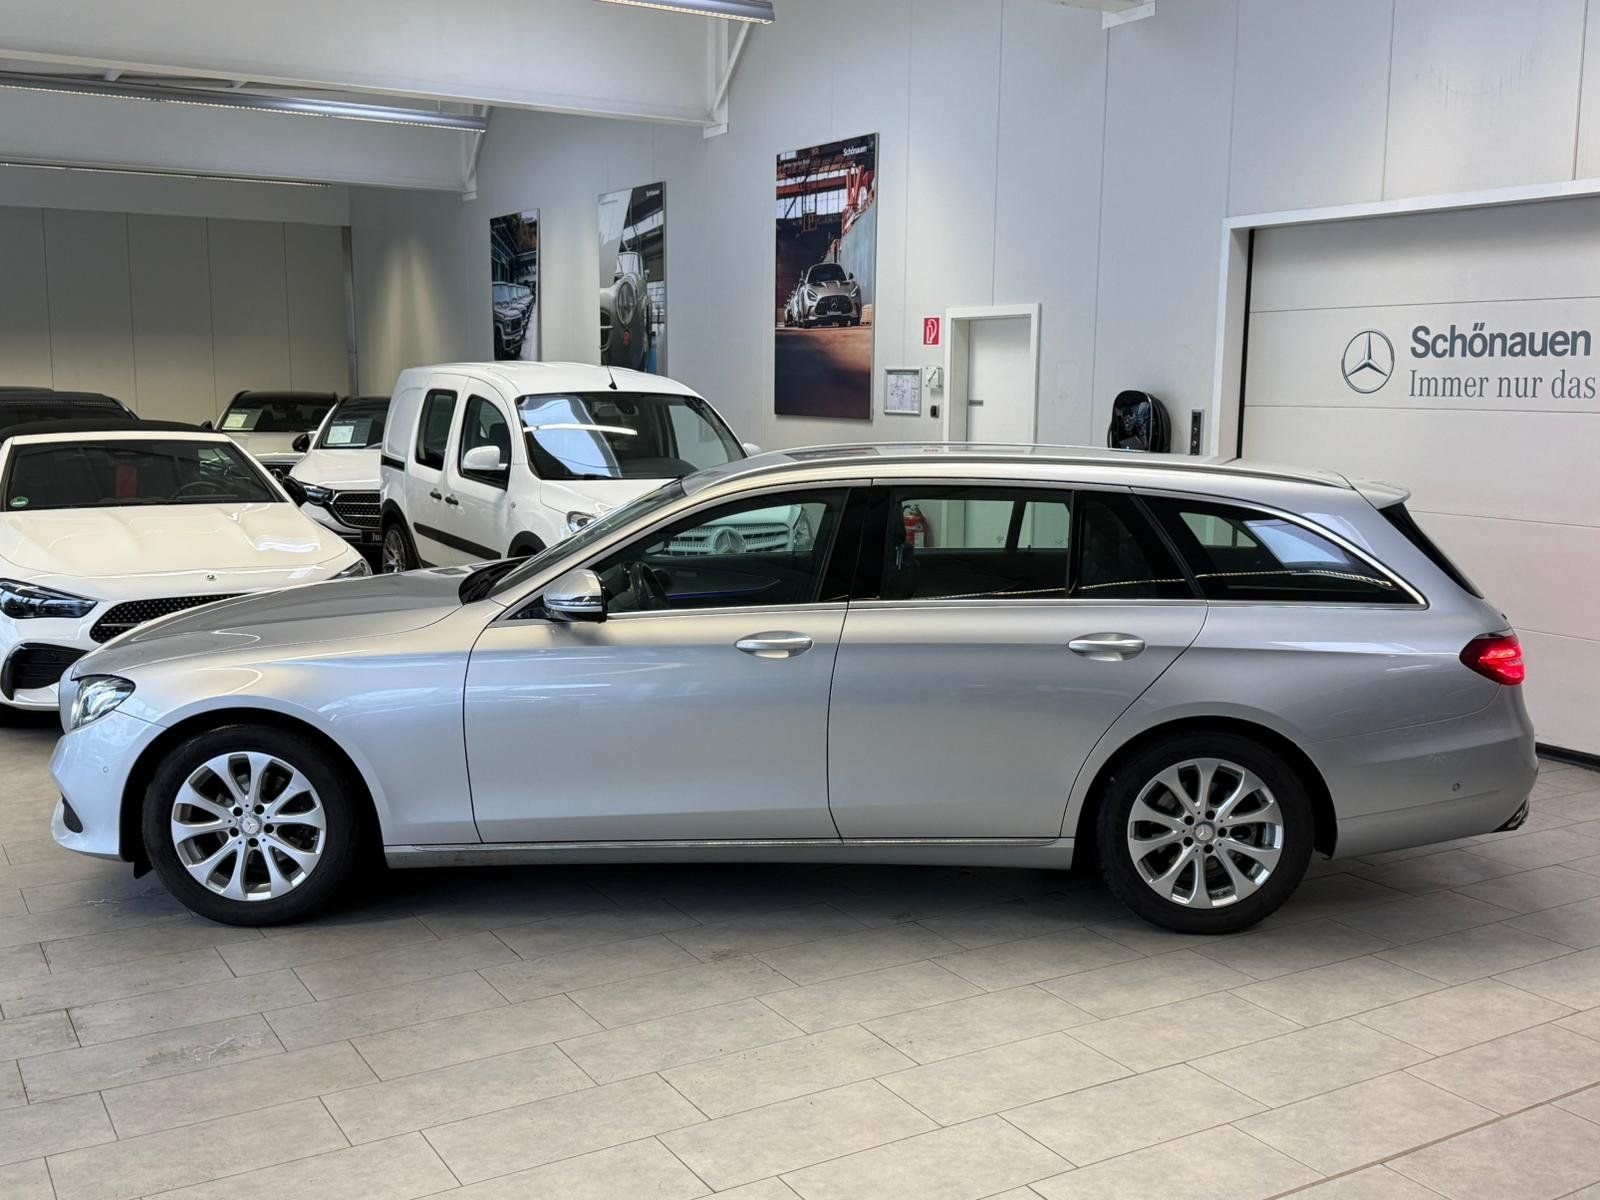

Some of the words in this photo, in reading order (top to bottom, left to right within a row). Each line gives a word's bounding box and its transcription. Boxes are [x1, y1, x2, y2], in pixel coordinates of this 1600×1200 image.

[1411, 323, 1591, 359] Schönauen
[1409, 369, 1489, 397] Immer
[1496, 375, 1543, 398] nur
[1551, 369, 1596, 399] das
